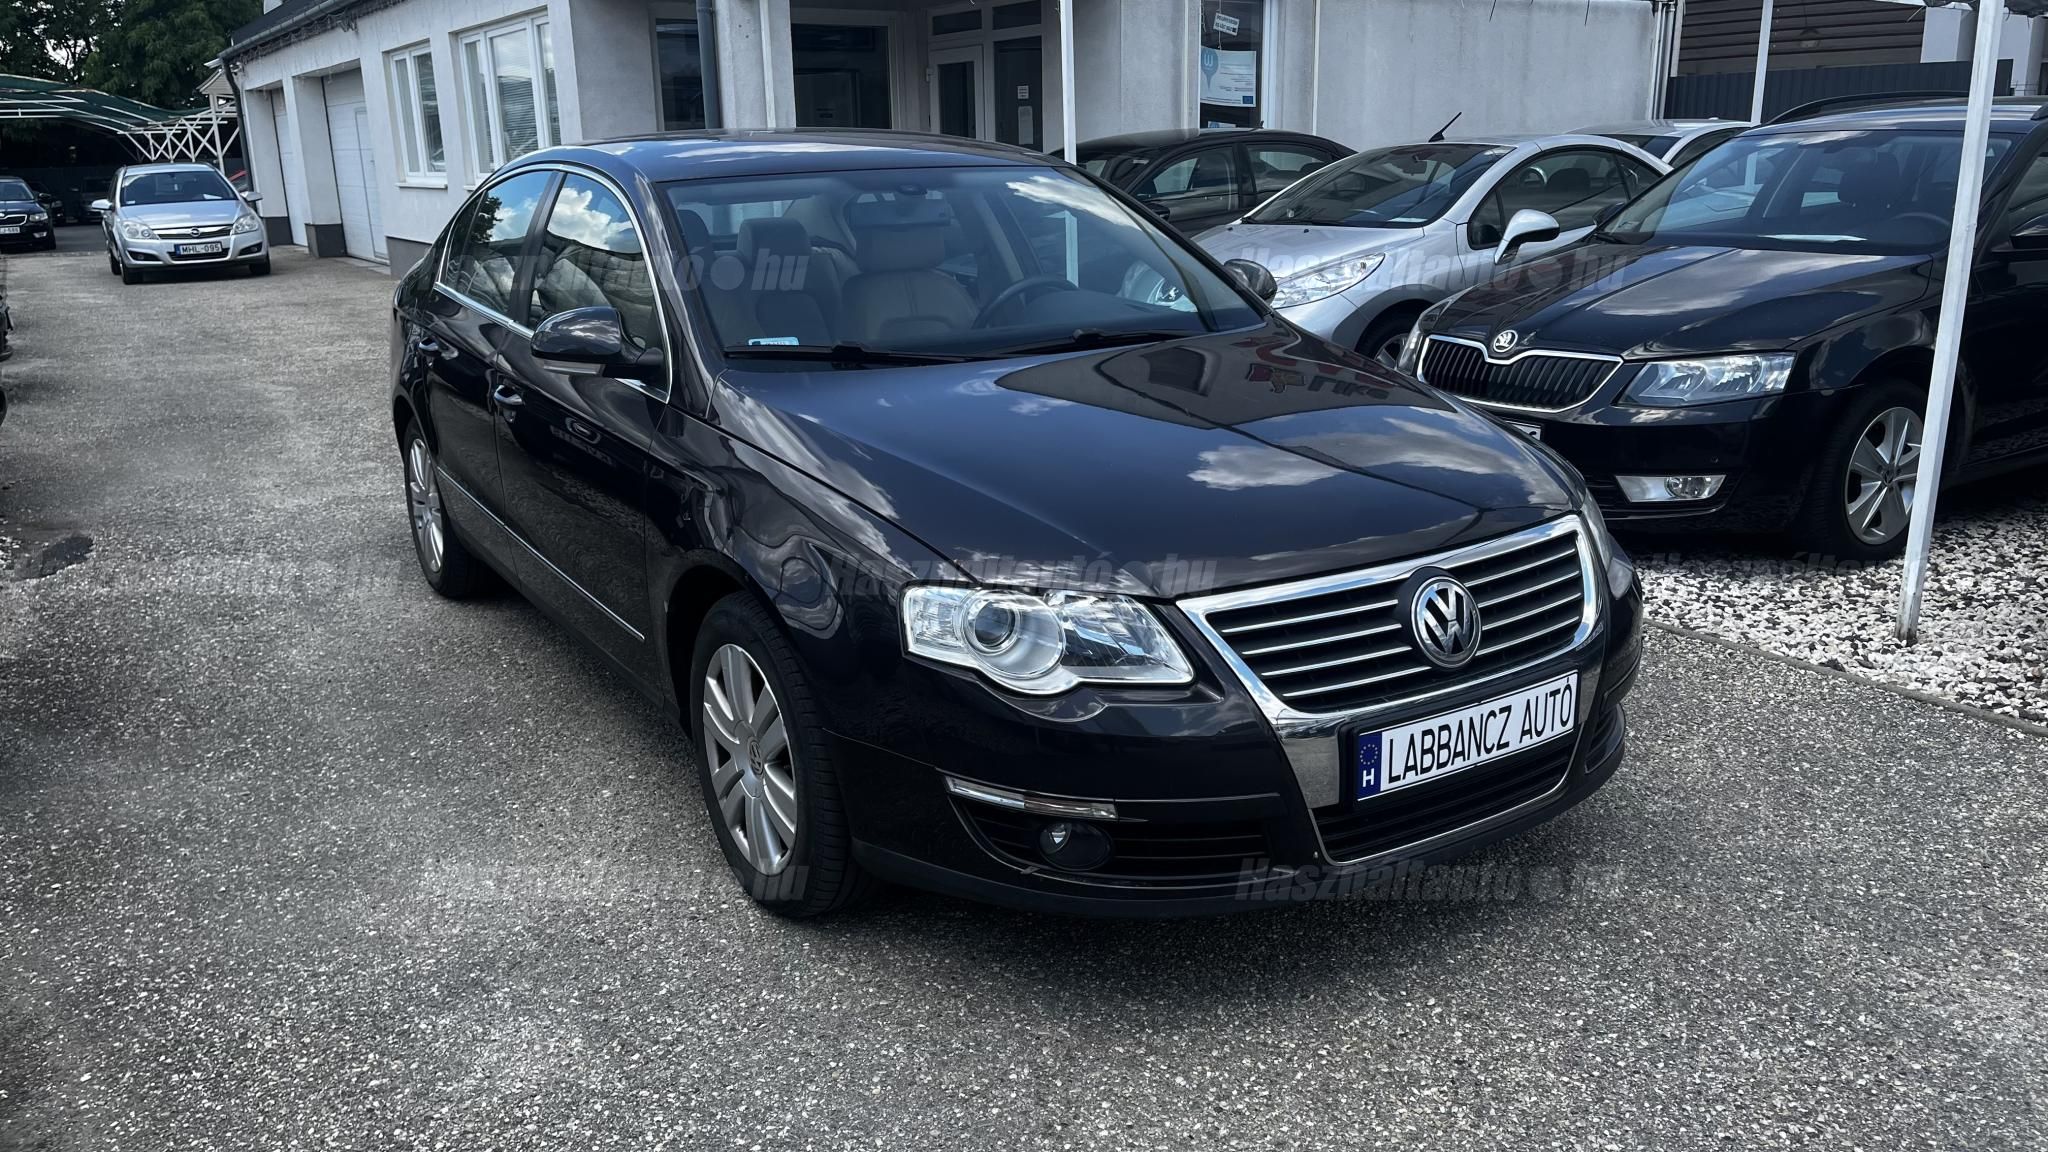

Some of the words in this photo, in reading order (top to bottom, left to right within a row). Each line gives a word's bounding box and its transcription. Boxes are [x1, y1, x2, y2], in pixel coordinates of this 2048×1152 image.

[182, 244, 219, 253] MHL-095
[1388, 705, 1513, 784] LABBANCZ
[1519, 677, 1573, 744] AUTÓ
[1362, 768, 1375, 787] H
